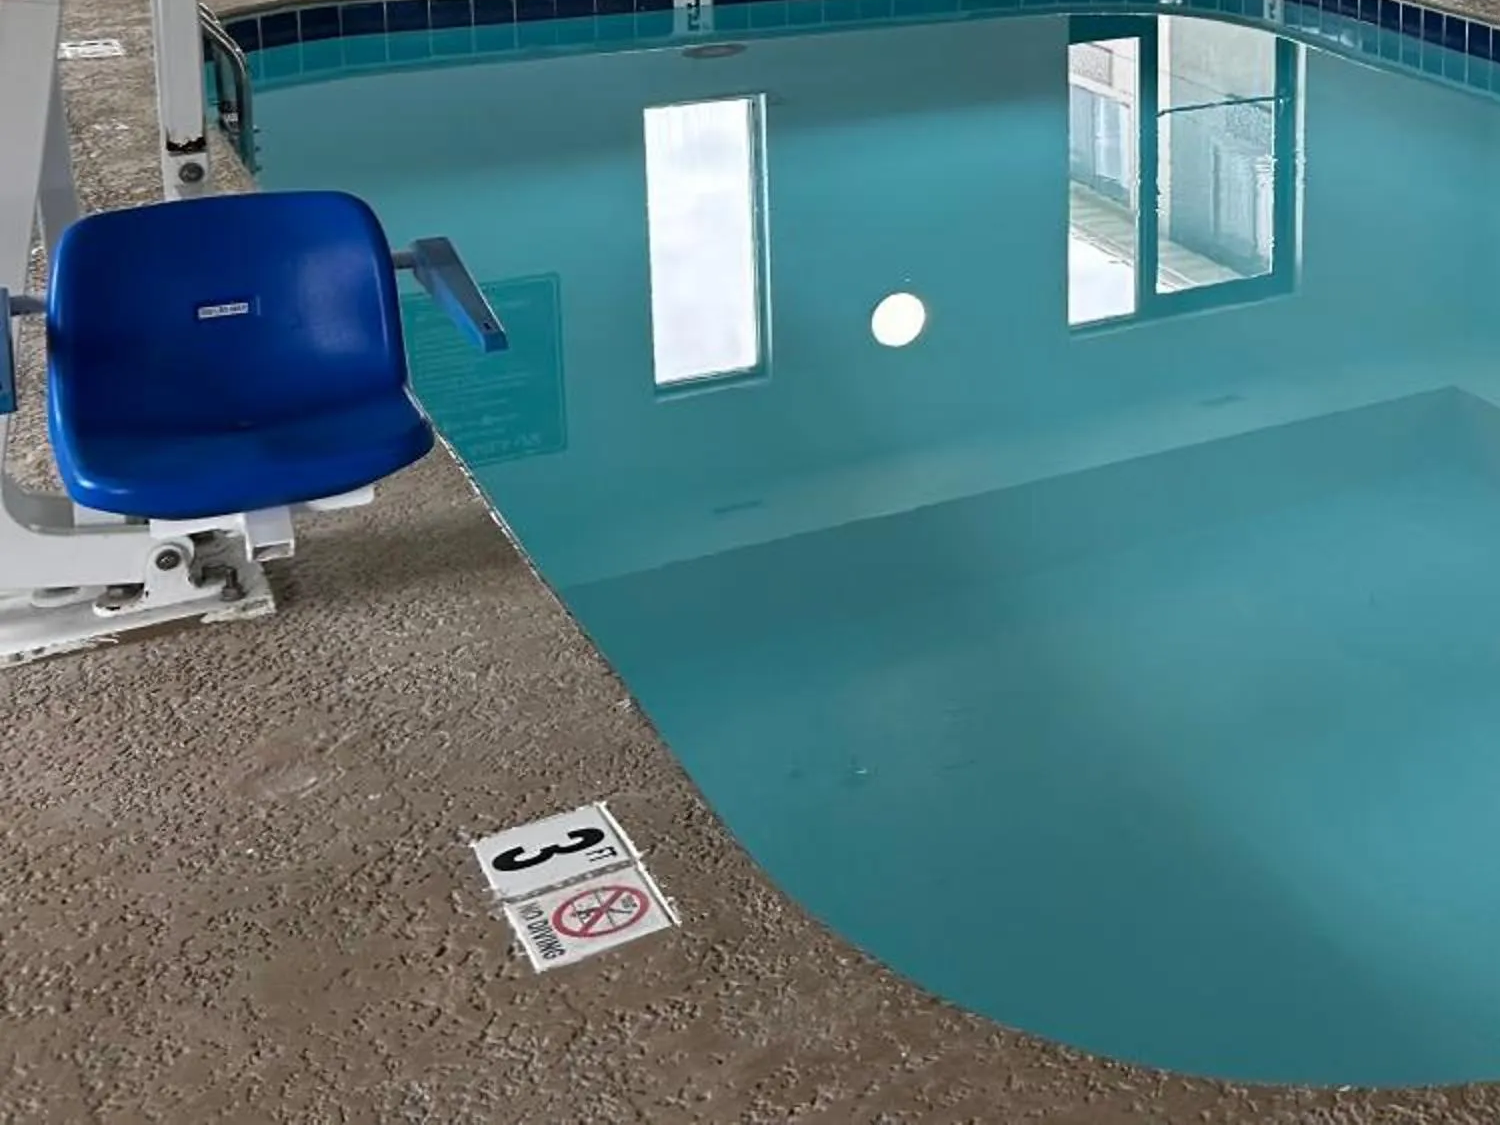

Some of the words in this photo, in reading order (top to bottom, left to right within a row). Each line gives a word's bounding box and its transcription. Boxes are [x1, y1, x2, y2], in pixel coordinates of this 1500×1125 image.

[492, 828, 605, 872] 3
[585, 846, 618, 863] FT
[527, 918, 566, 960] DIVING
